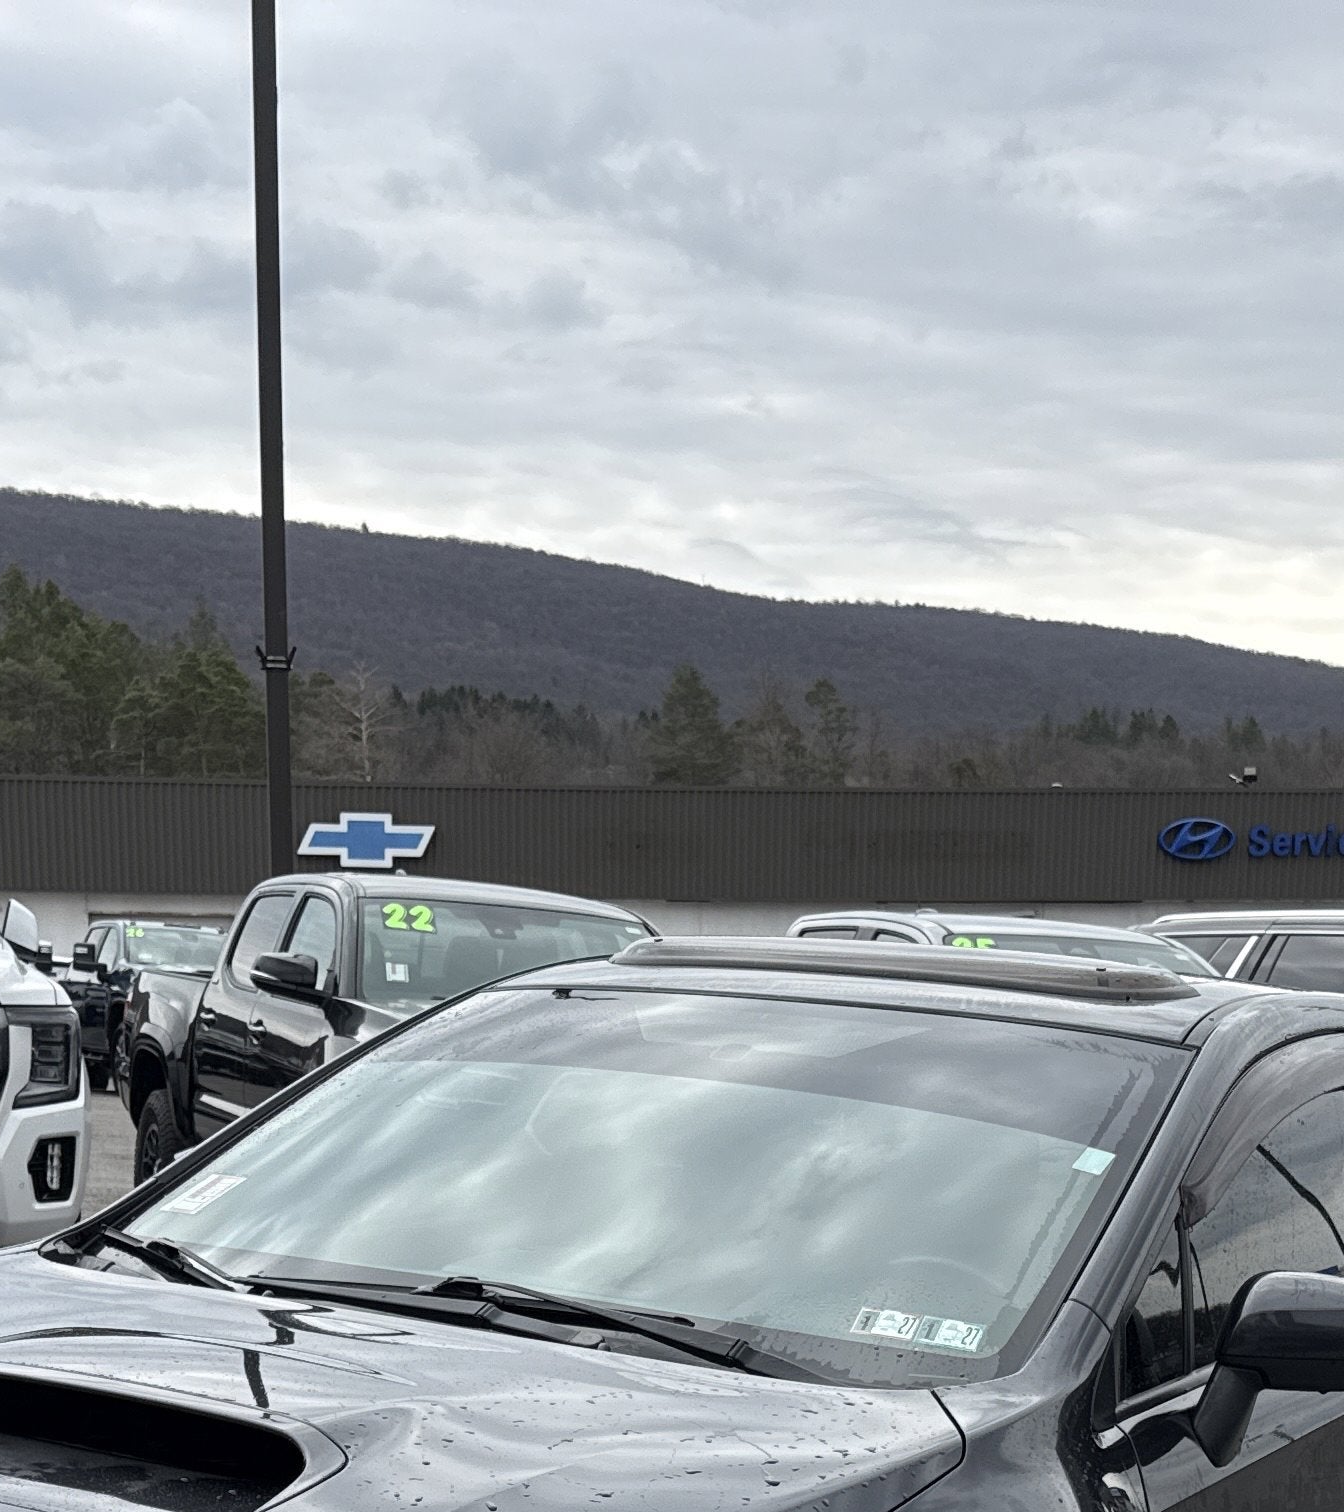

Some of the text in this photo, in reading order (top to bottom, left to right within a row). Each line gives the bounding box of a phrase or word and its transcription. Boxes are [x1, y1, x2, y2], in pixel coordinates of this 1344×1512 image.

[382, 903, 436, 933] 22
[898, 1316, 917, 1336] 27
[961, 1326, 980, 1346] 27
